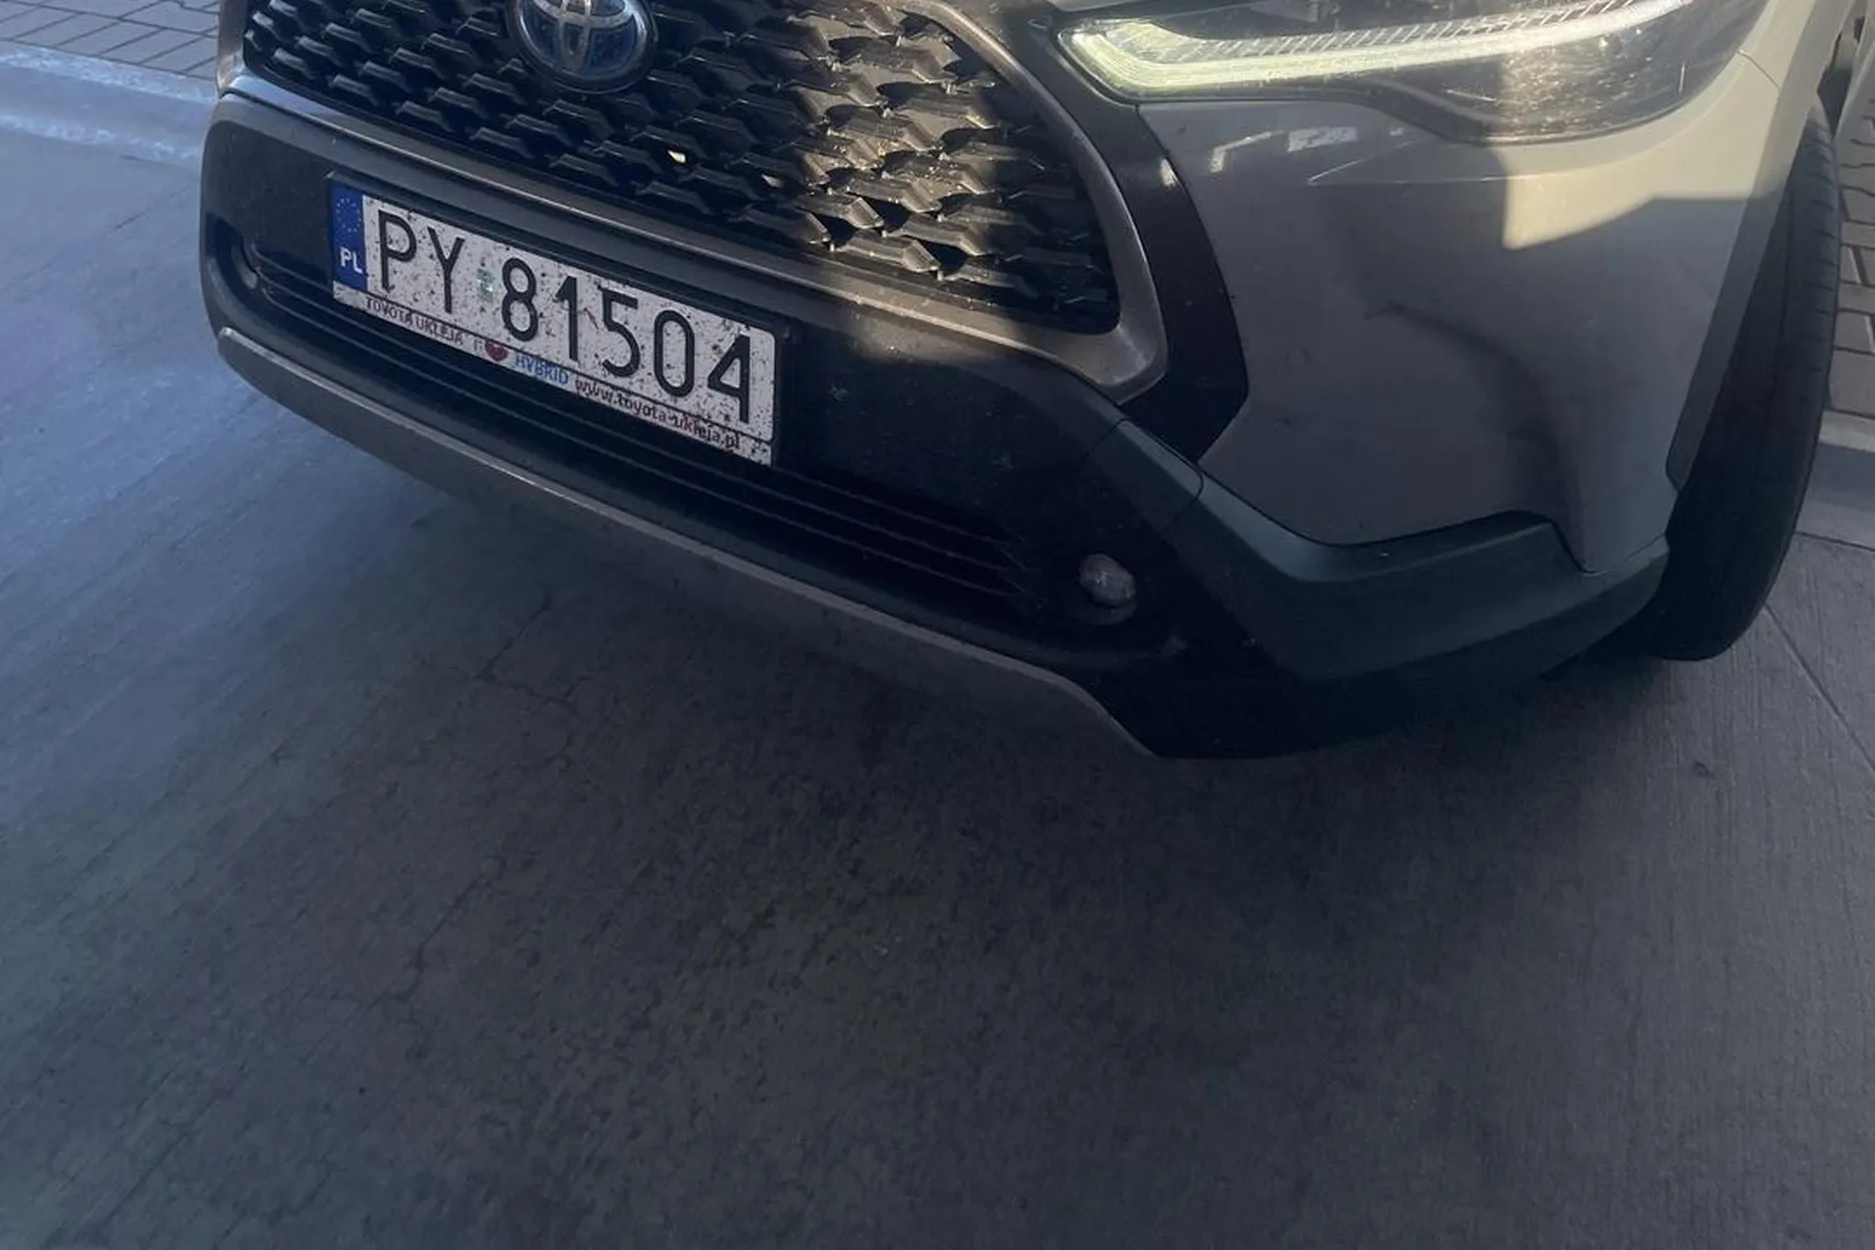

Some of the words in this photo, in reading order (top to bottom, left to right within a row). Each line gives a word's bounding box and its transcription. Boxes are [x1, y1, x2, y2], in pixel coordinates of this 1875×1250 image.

[340, 246, 363, 274] PL
[366, 296, 413, 325] TOYOTA
[416, 317, 463, 346] UKLEJA
[515, 353, 569, 384] HYBRID
[378, 209, 466, 314] PY
[502, 257, 750, 424] 81504
